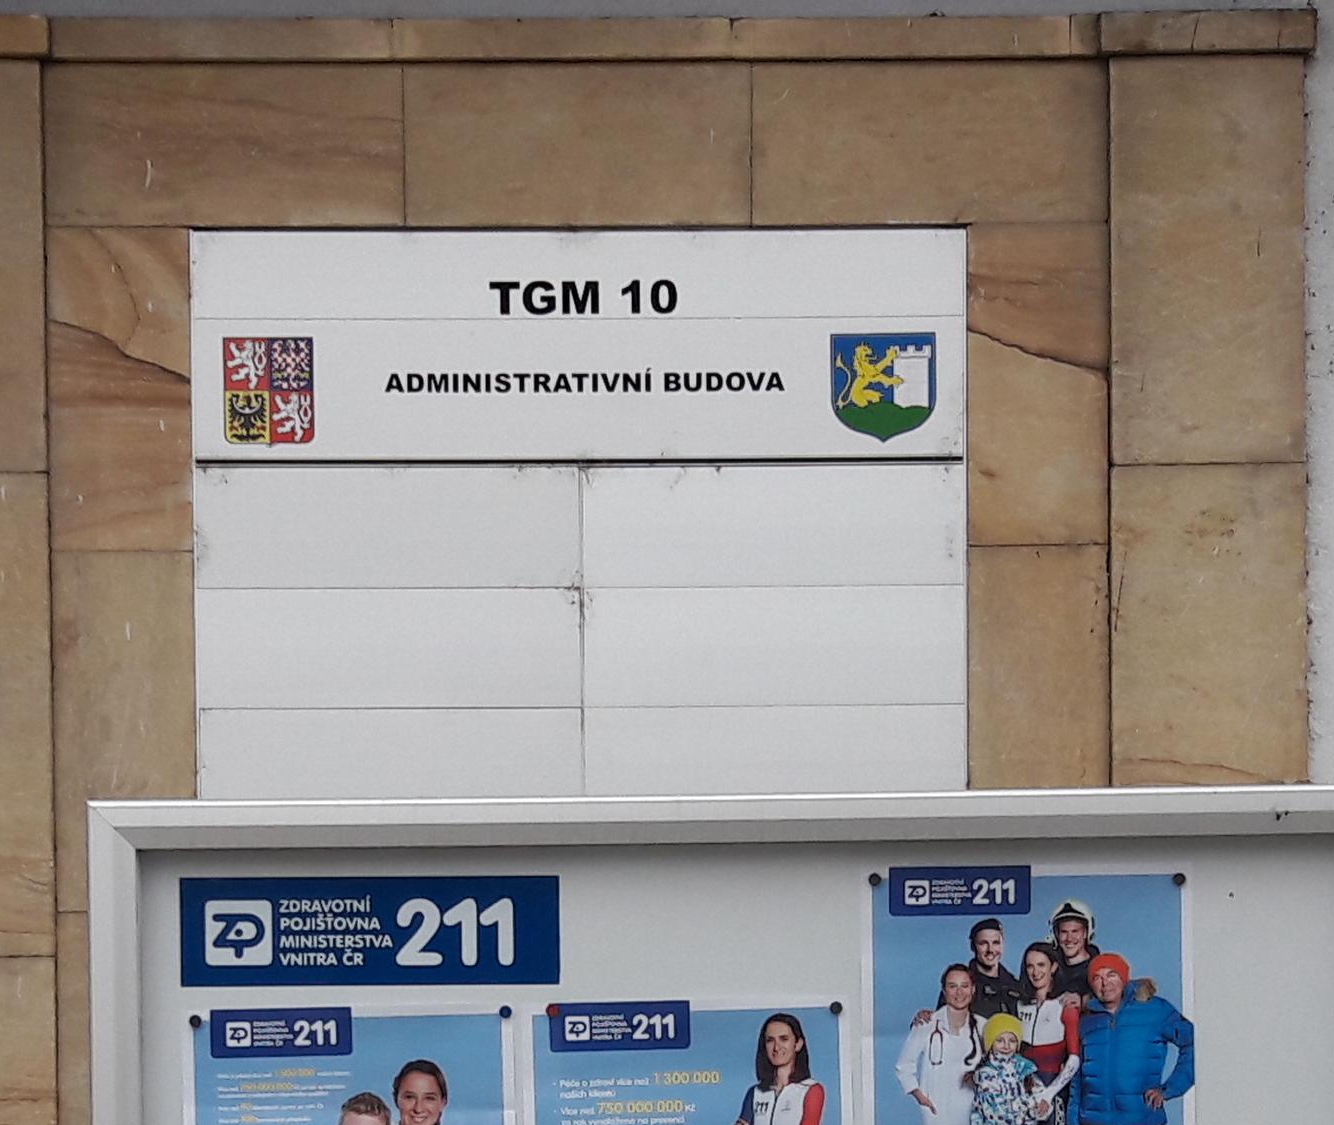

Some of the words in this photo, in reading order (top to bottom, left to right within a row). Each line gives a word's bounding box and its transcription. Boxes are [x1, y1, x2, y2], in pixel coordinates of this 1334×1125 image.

[489, 280, 600, 315] TGM
[620, 279, 678, 314] 10
[384, 367, 652, 393] ADMINISTRATIVNÍ
[663, 371, 785, 393] BUDOVA
[278, 895, 371, 913] ZDRAVOTNÍ
[972, 879, 1016, 905] 211
[279, 912, 381, 931] POJIŠŤOVNA
[395, 898, 515, 967] 211
[279, 934, 393, 949] MINISTERSTVA
[279, 952, 338, 967] VNITRA
[343, 948, 364, 967] ČR
[294, 1019, 337, 1046] 211
[632, 1013, 675, 1040] 211
